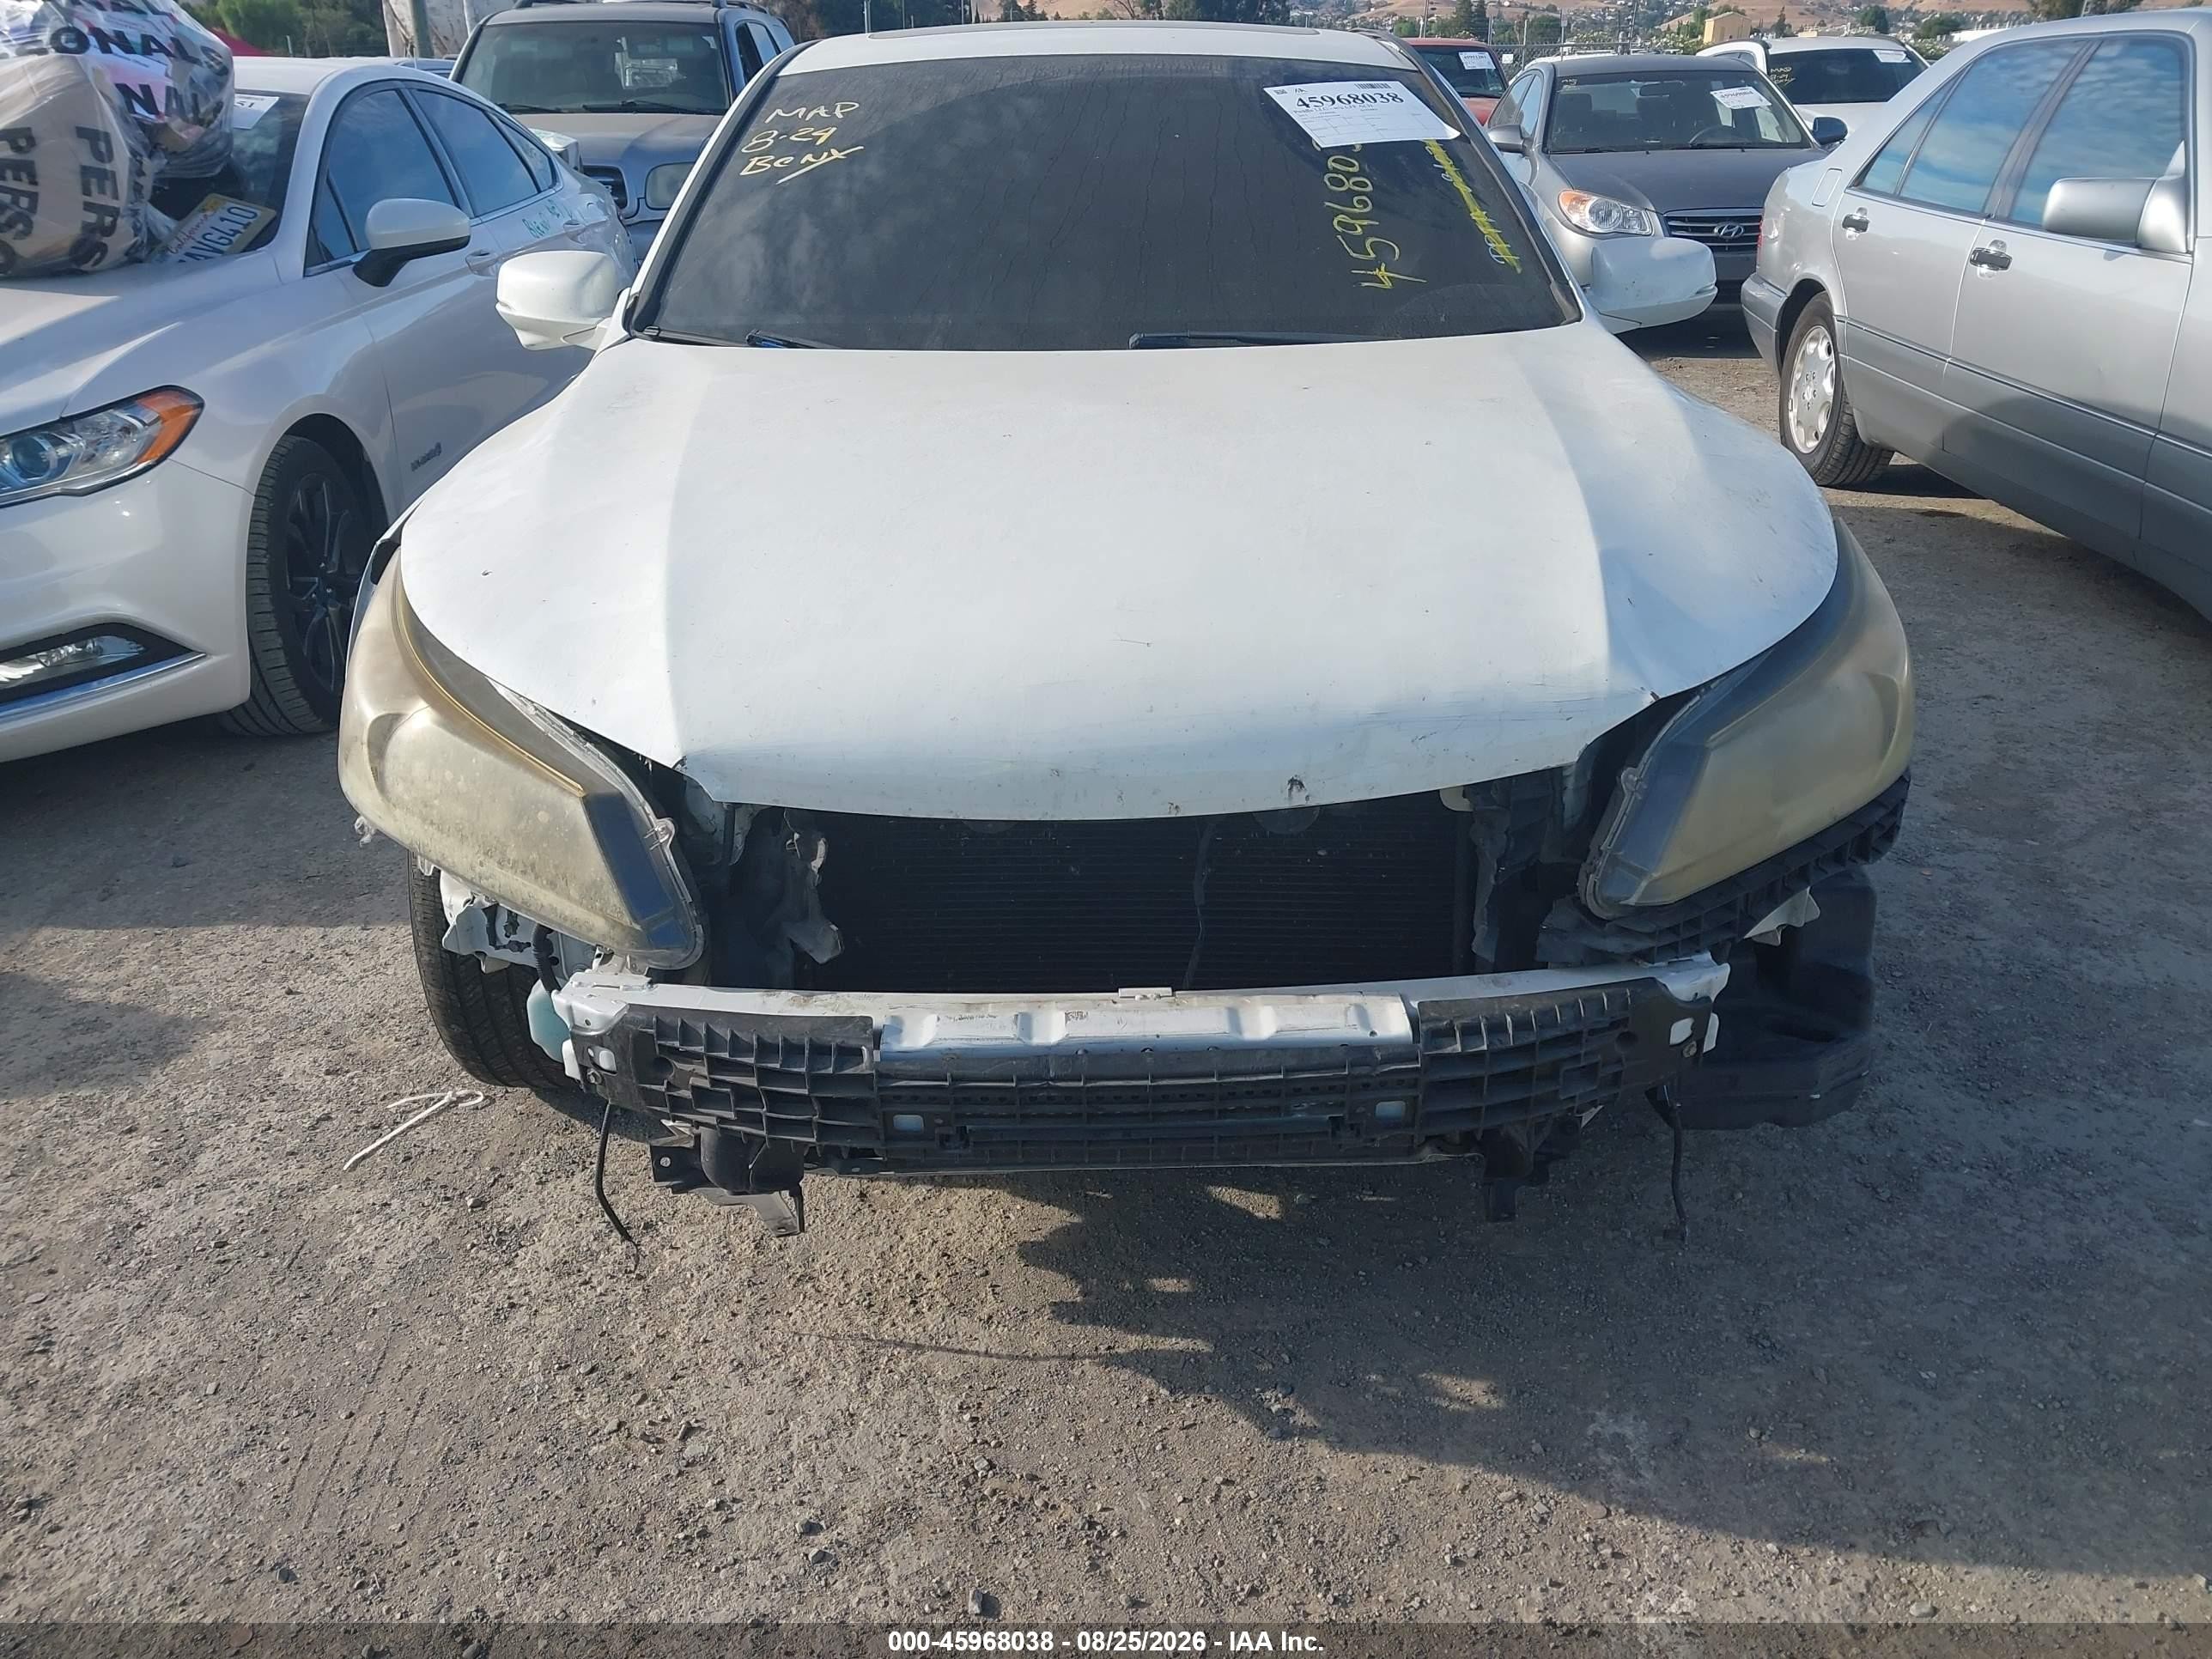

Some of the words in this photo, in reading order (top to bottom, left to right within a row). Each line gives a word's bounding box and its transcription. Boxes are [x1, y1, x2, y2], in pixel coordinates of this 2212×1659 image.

[764, 101, 860, 125] MAP
[1297, 92, 1404, 109] 45968038
[177, 205, 258, 264] AVG410
[1312, 138, 1428, 290] 459680
